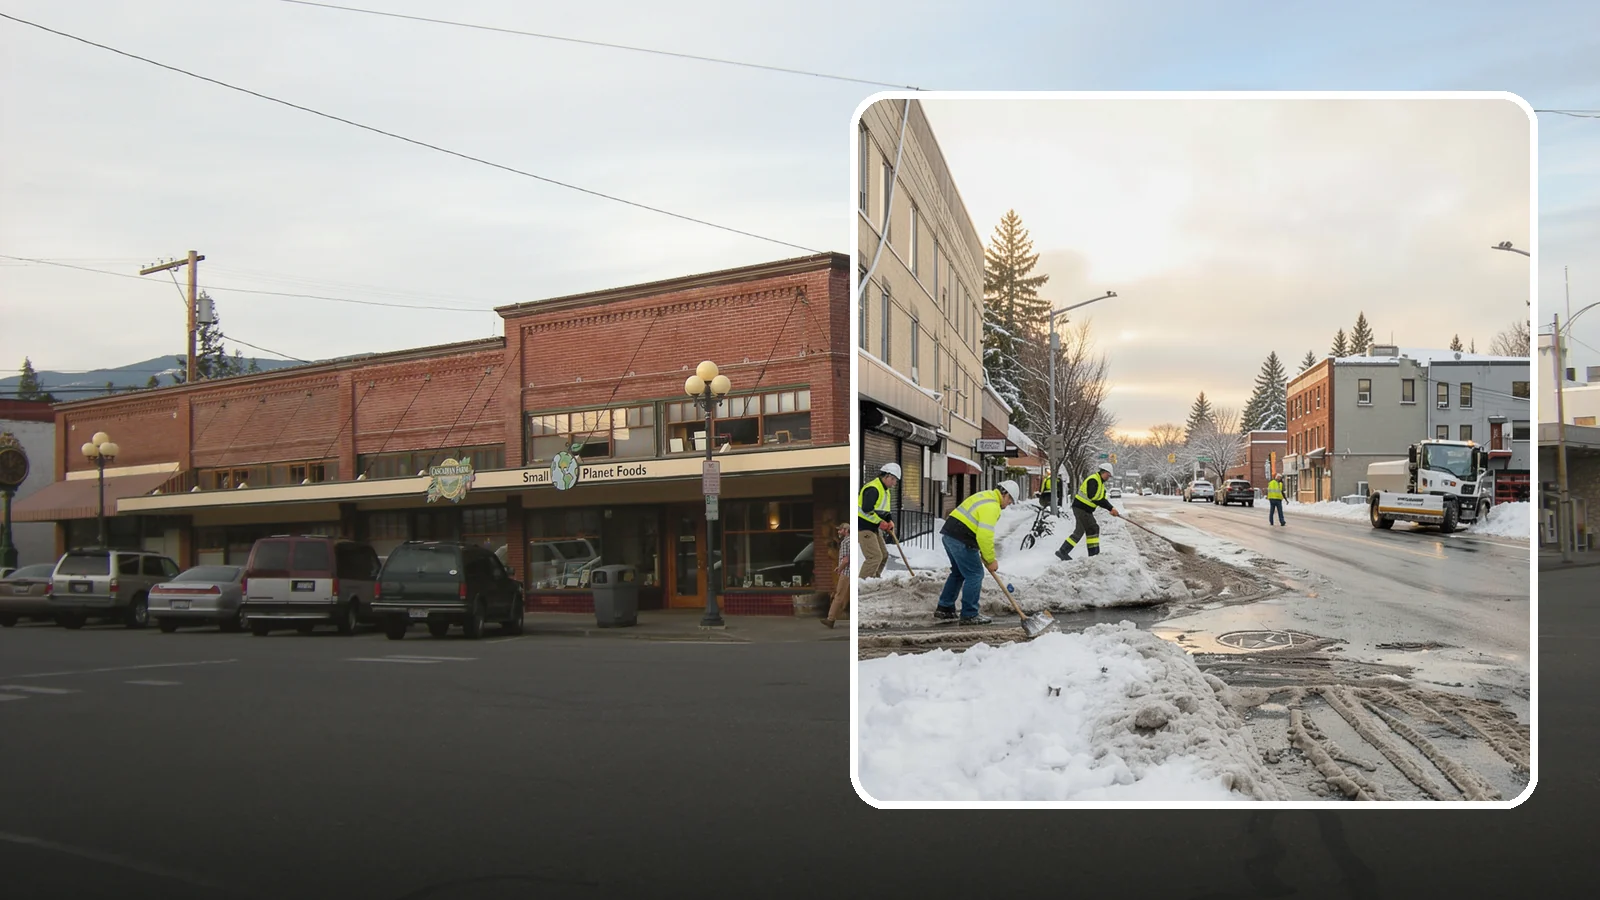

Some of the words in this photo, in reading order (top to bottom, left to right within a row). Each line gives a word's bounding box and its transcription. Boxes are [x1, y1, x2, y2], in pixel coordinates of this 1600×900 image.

[522, 471, 549, 483] Small
[582, 467, 614, 479] Planet
[616, 464, 647, 477] Foods
